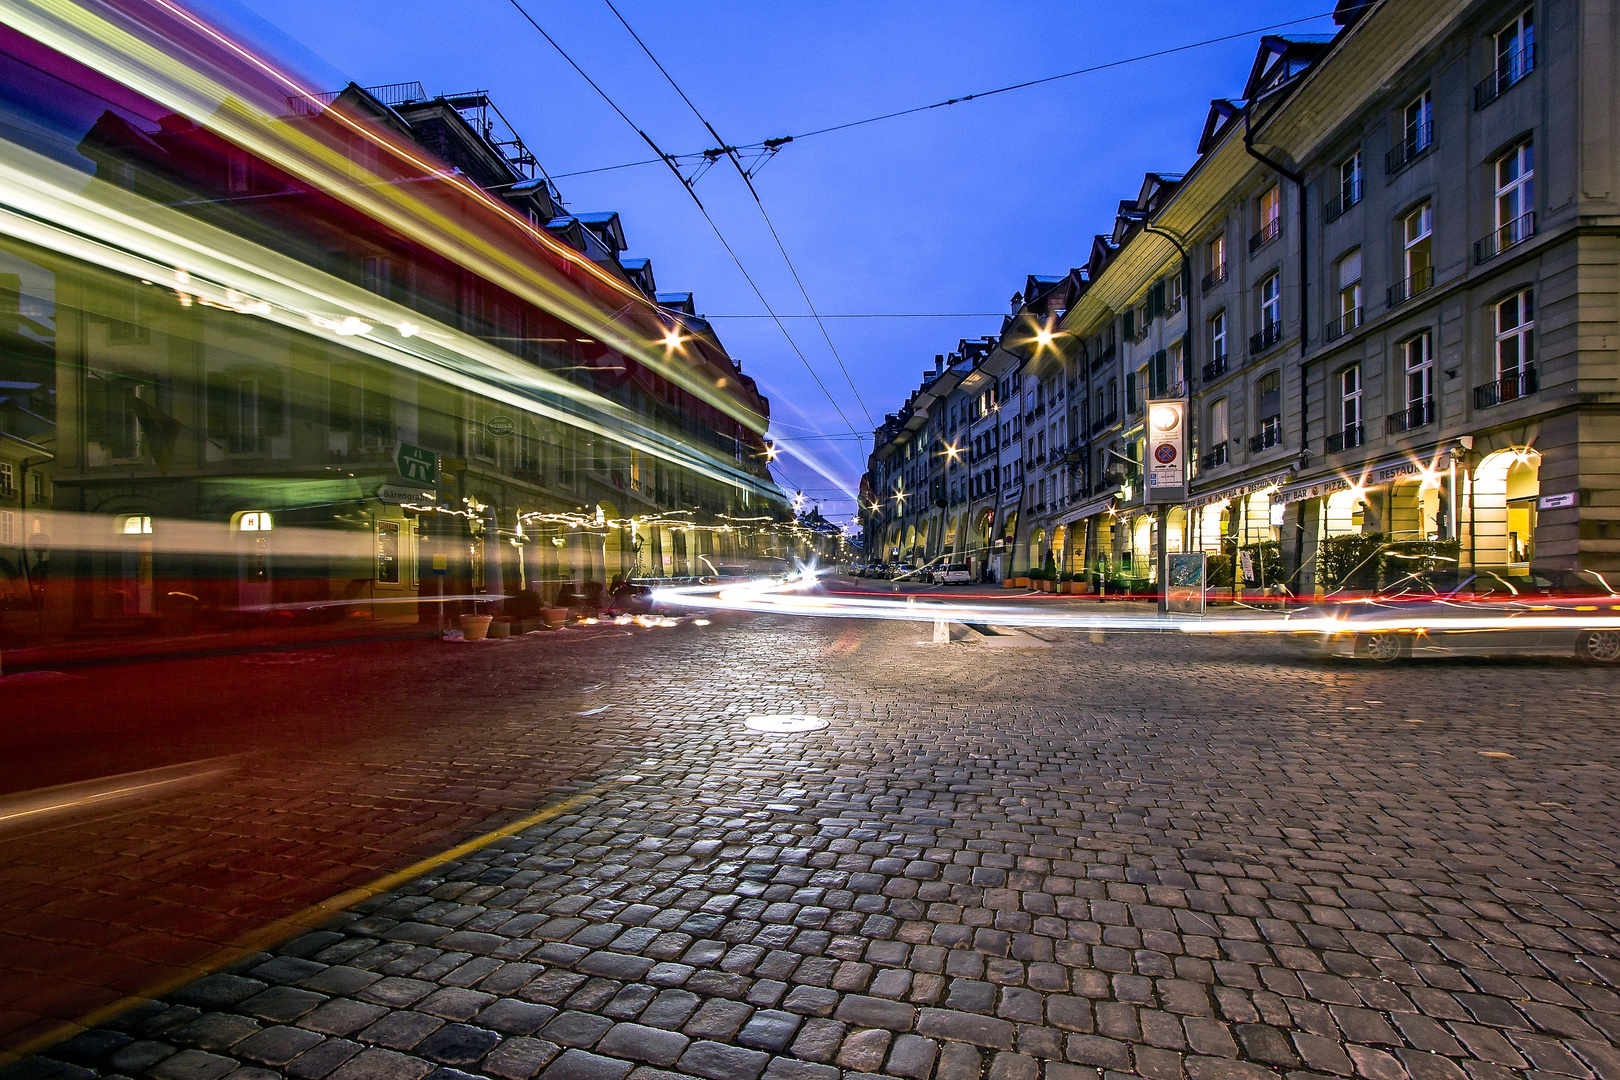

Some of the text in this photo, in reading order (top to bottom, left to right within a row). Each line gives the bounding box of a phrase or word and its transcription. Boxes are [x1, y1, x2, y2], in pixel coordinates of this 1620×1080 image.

[1293, 489, 1307, 500] BAR
[1379, 456, 1442, 480] RESTAURN
[383, 489, 433, 503] Bärengrab
[1197, 497, 1206, 506] BAR
[248, 518, 254, 526] H
